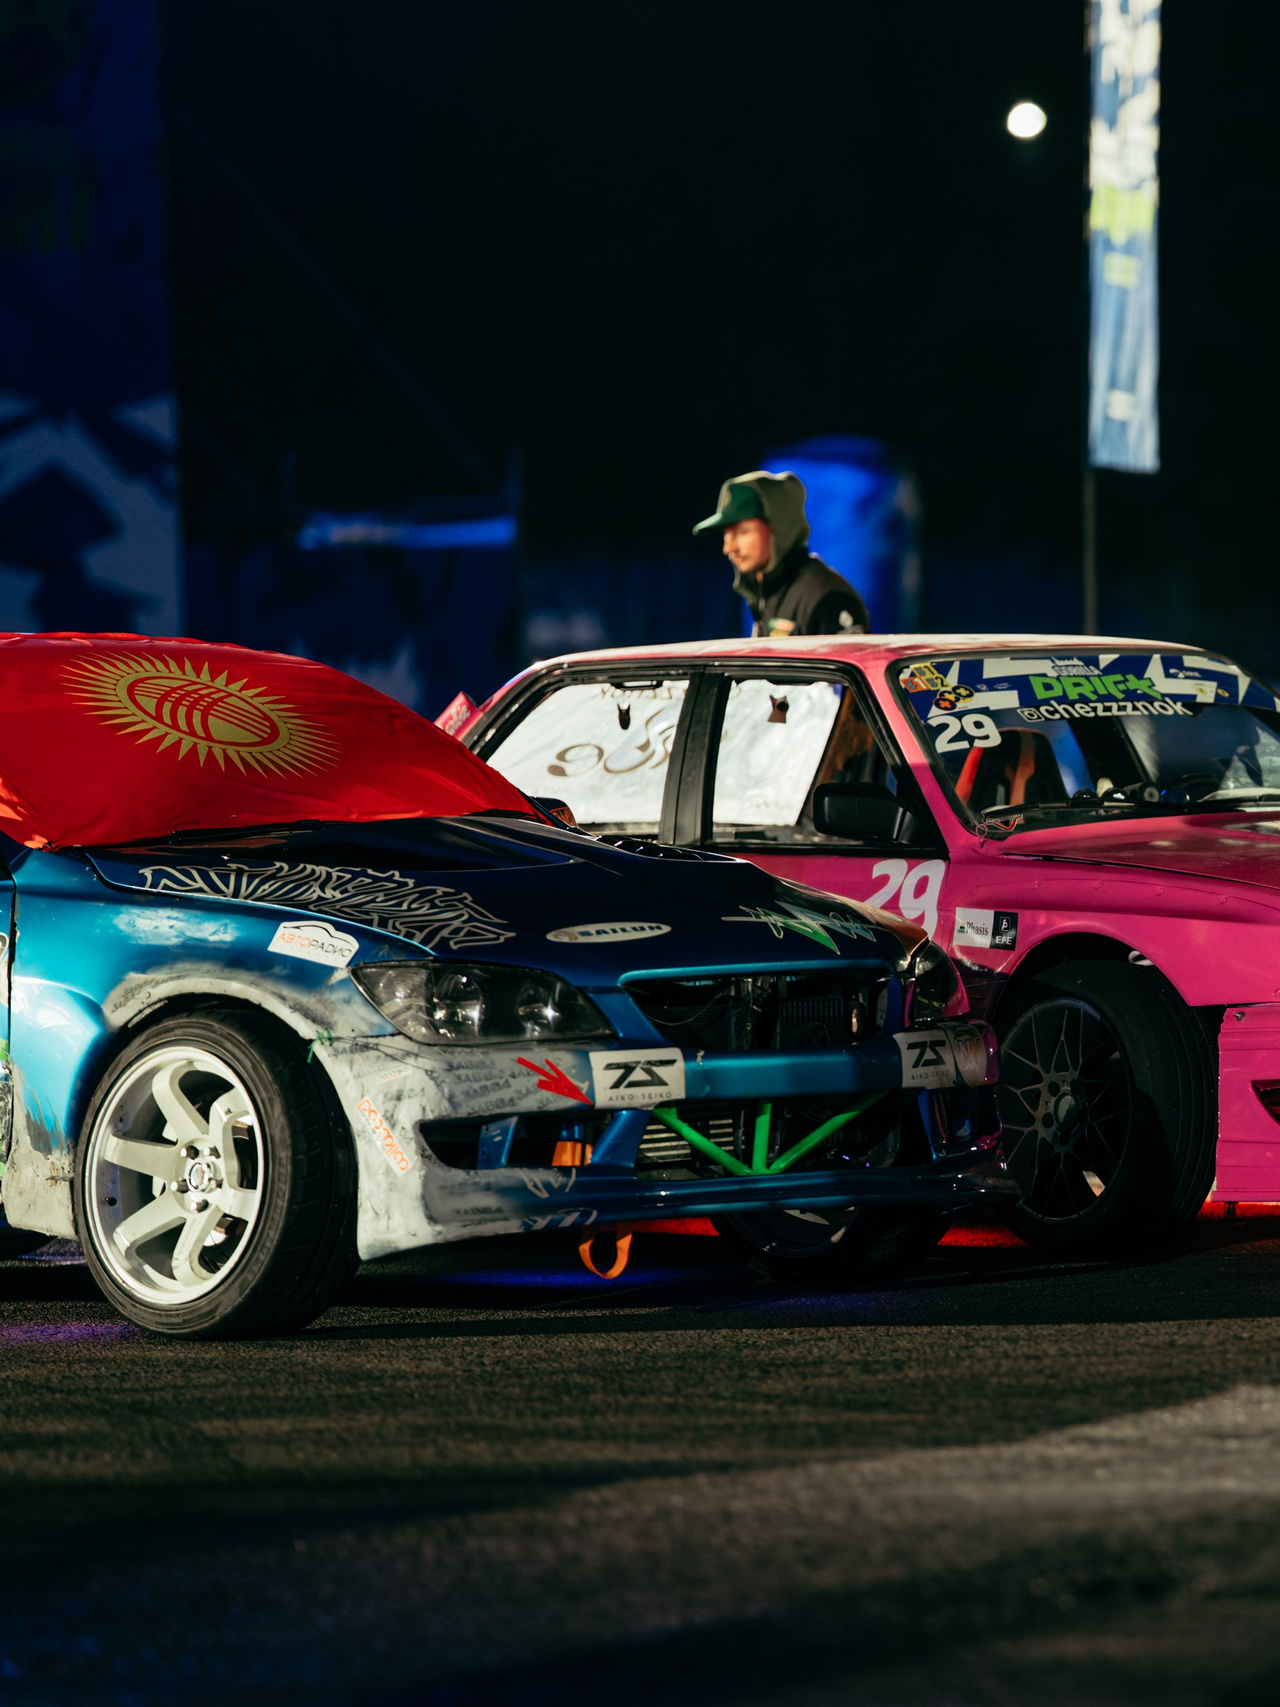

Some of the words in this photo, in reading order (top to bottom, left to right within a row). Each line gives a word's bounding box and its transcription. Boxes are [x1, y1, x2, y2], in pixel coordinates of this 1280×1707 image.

[927, 713, 1002, 754] 29
[863, 858, 946, 940] 29
[577, 924, 663, 937] SAILUN
[966, 921, 989, 936] Phasis
